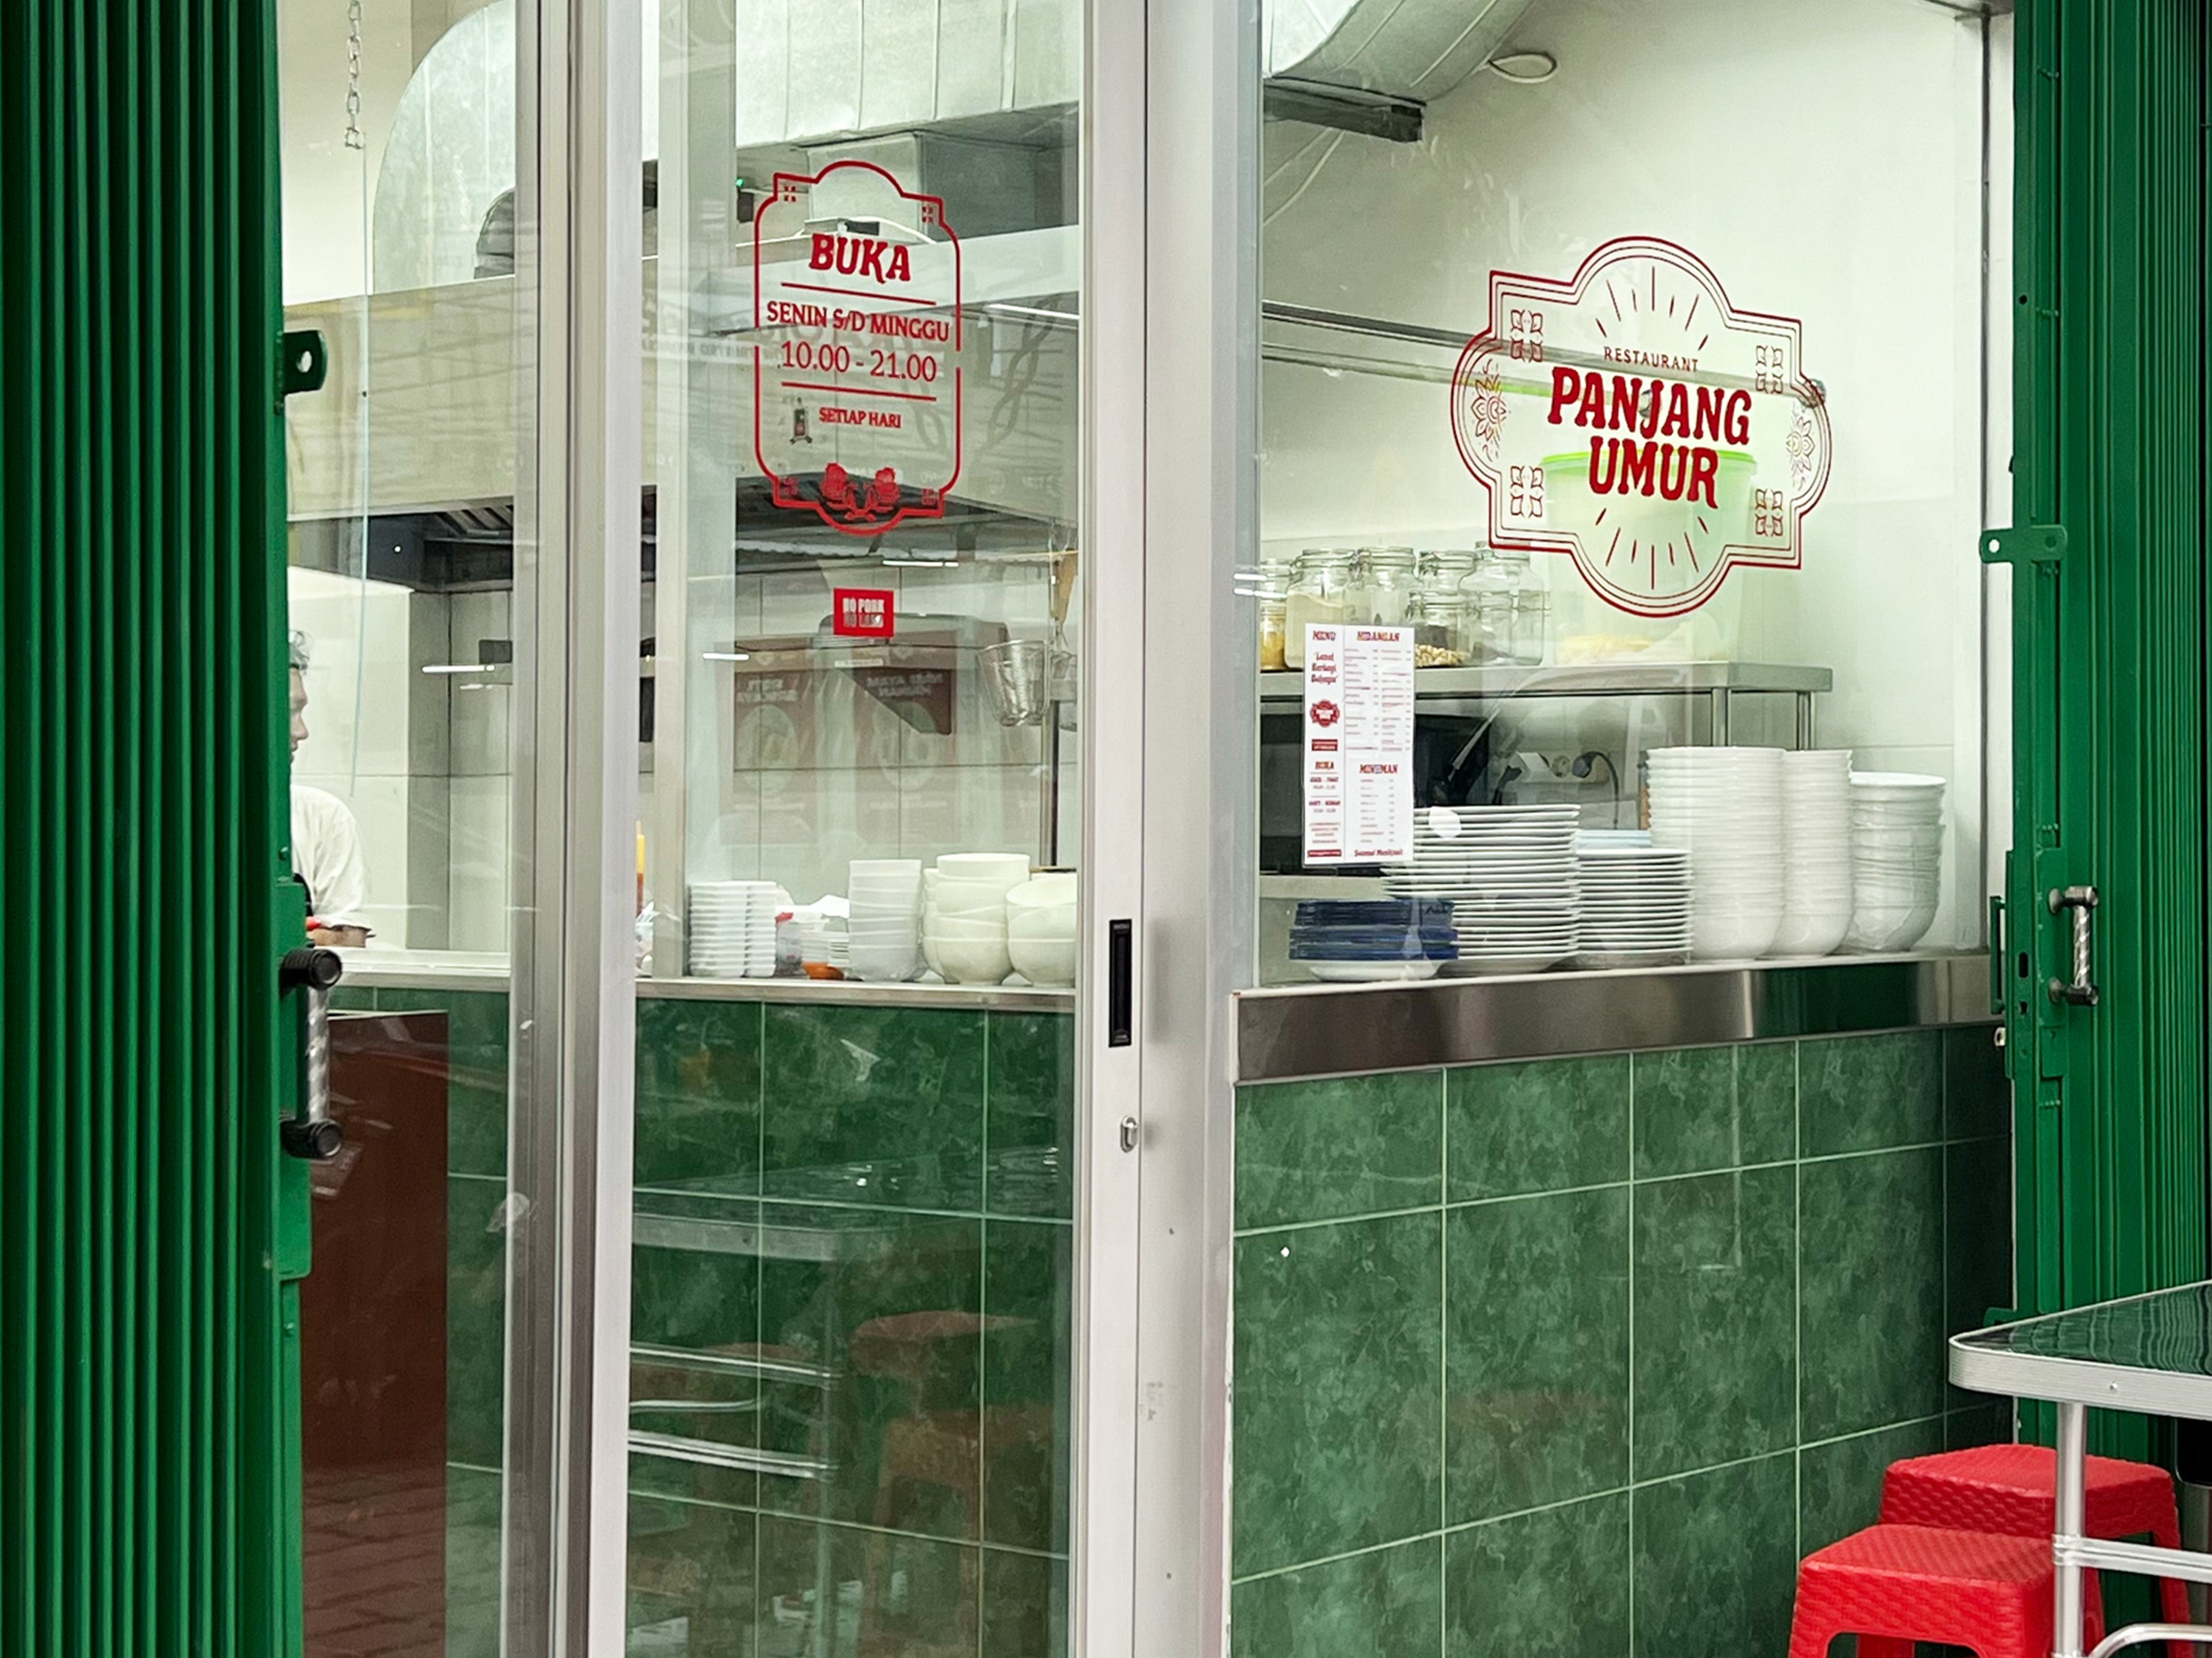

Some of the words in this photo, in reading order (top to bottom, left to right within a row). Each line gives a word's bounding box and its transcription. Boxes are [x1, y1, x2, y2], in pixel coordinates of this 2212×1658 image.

[810, 232, 912, 284] BUKA
[767, 300, 829, 328] SENIN
[833, 308, 866, 333] S/D
[869, 313, 951, 343] MINGGU
[782, 340, 850, 373] 10.00
[869, 349, 938, 382] 21.00
[1604, 346, 1700, 372] RESTAURANT
[819, 406, 866, 426] SETIAP
[868, 411, 902, 429] HARI
[1547, 366, 1753, 445] PANJANG
[1588, 435, 1719, 509] UMUR
[843, 597, 857, 614] NO
[858, 598, 885, 614] PORK
